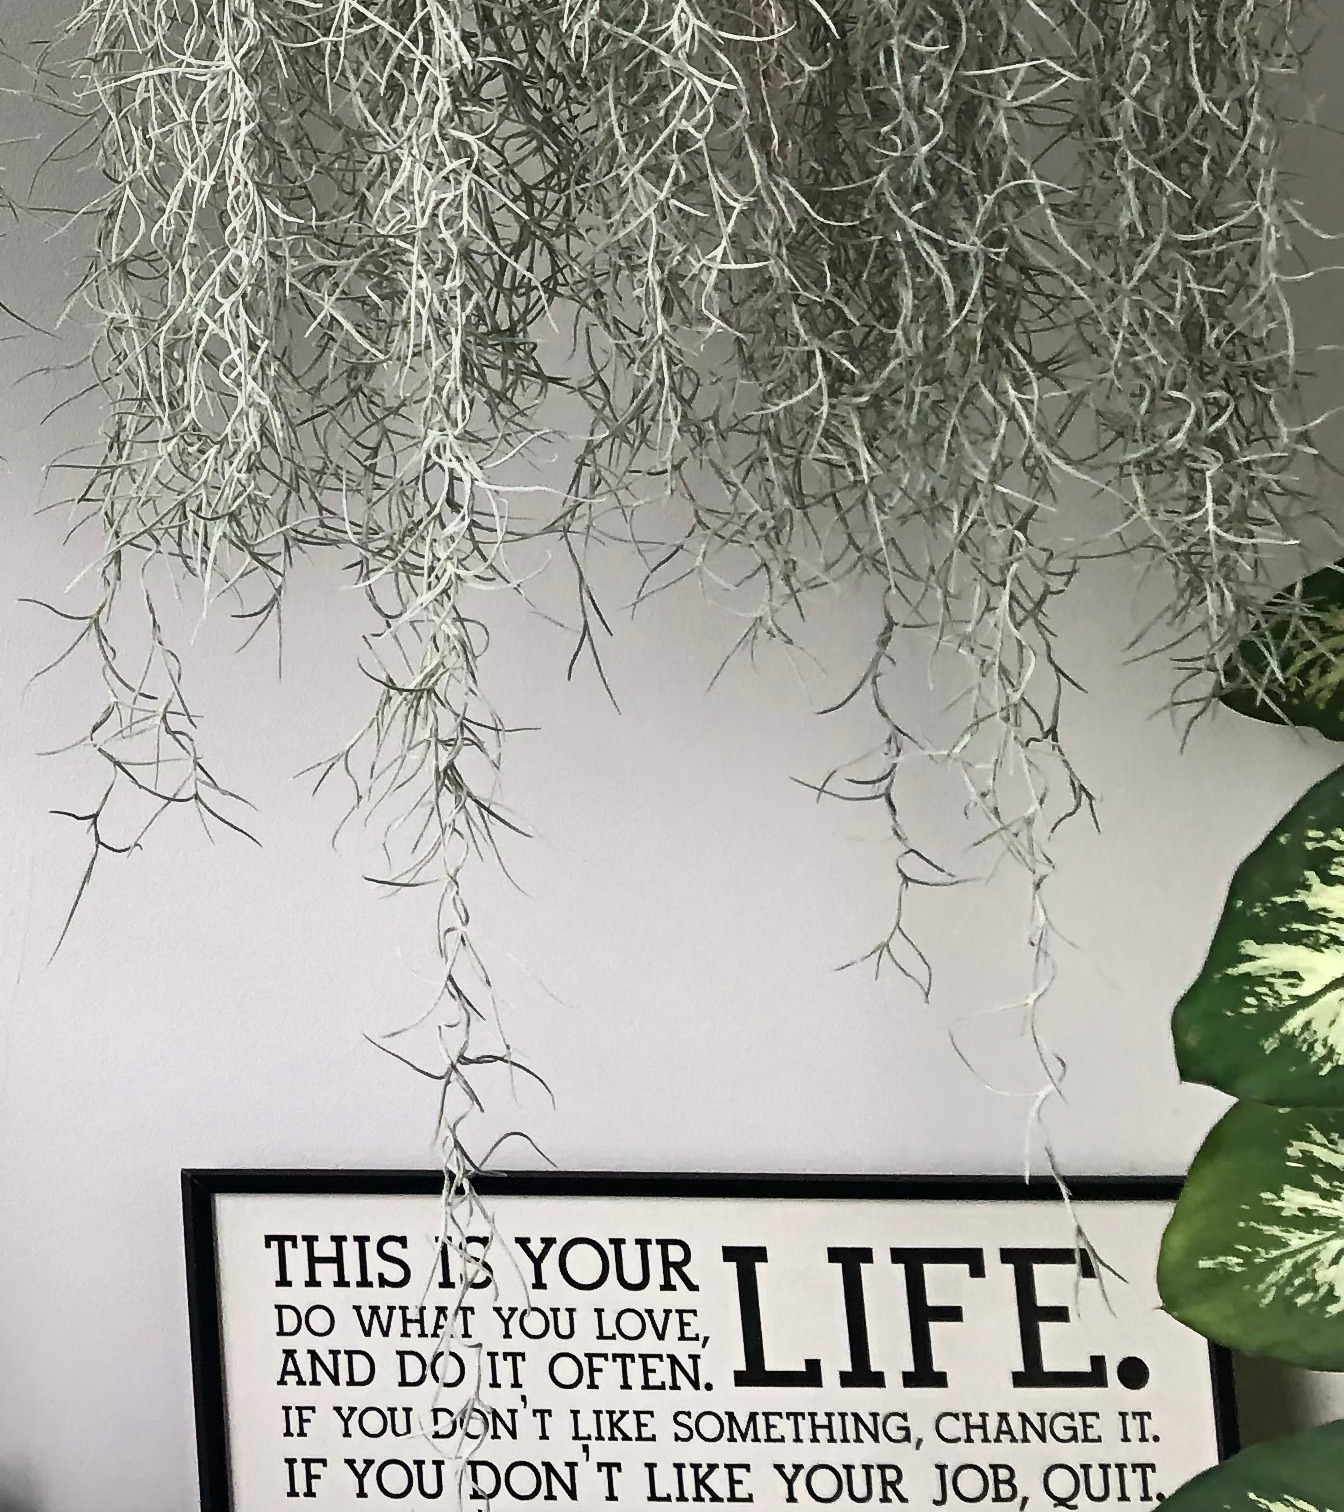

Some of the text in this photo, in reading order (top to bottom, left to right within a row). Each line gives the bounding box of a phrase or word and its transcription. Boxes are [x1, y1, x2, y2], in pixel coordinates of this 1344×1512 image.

[264, 1234, 700, 1292] THIS IS YOUR
[274, 1303, 711, 1349] DO WHAT YOU LOVE,
[721, 1245, 1150, 1391] LIFE.
[276, 1348, 714, 1392] AND DO IT OFTEN.
[281, 1394, 1161, 1450] IF YOU DON'T LIKE SOMETHING, CHANGE IT.
[283, 1444, 1165, 1511] IF YOU DON'T LIKE YOUR JOB, QUIT.
